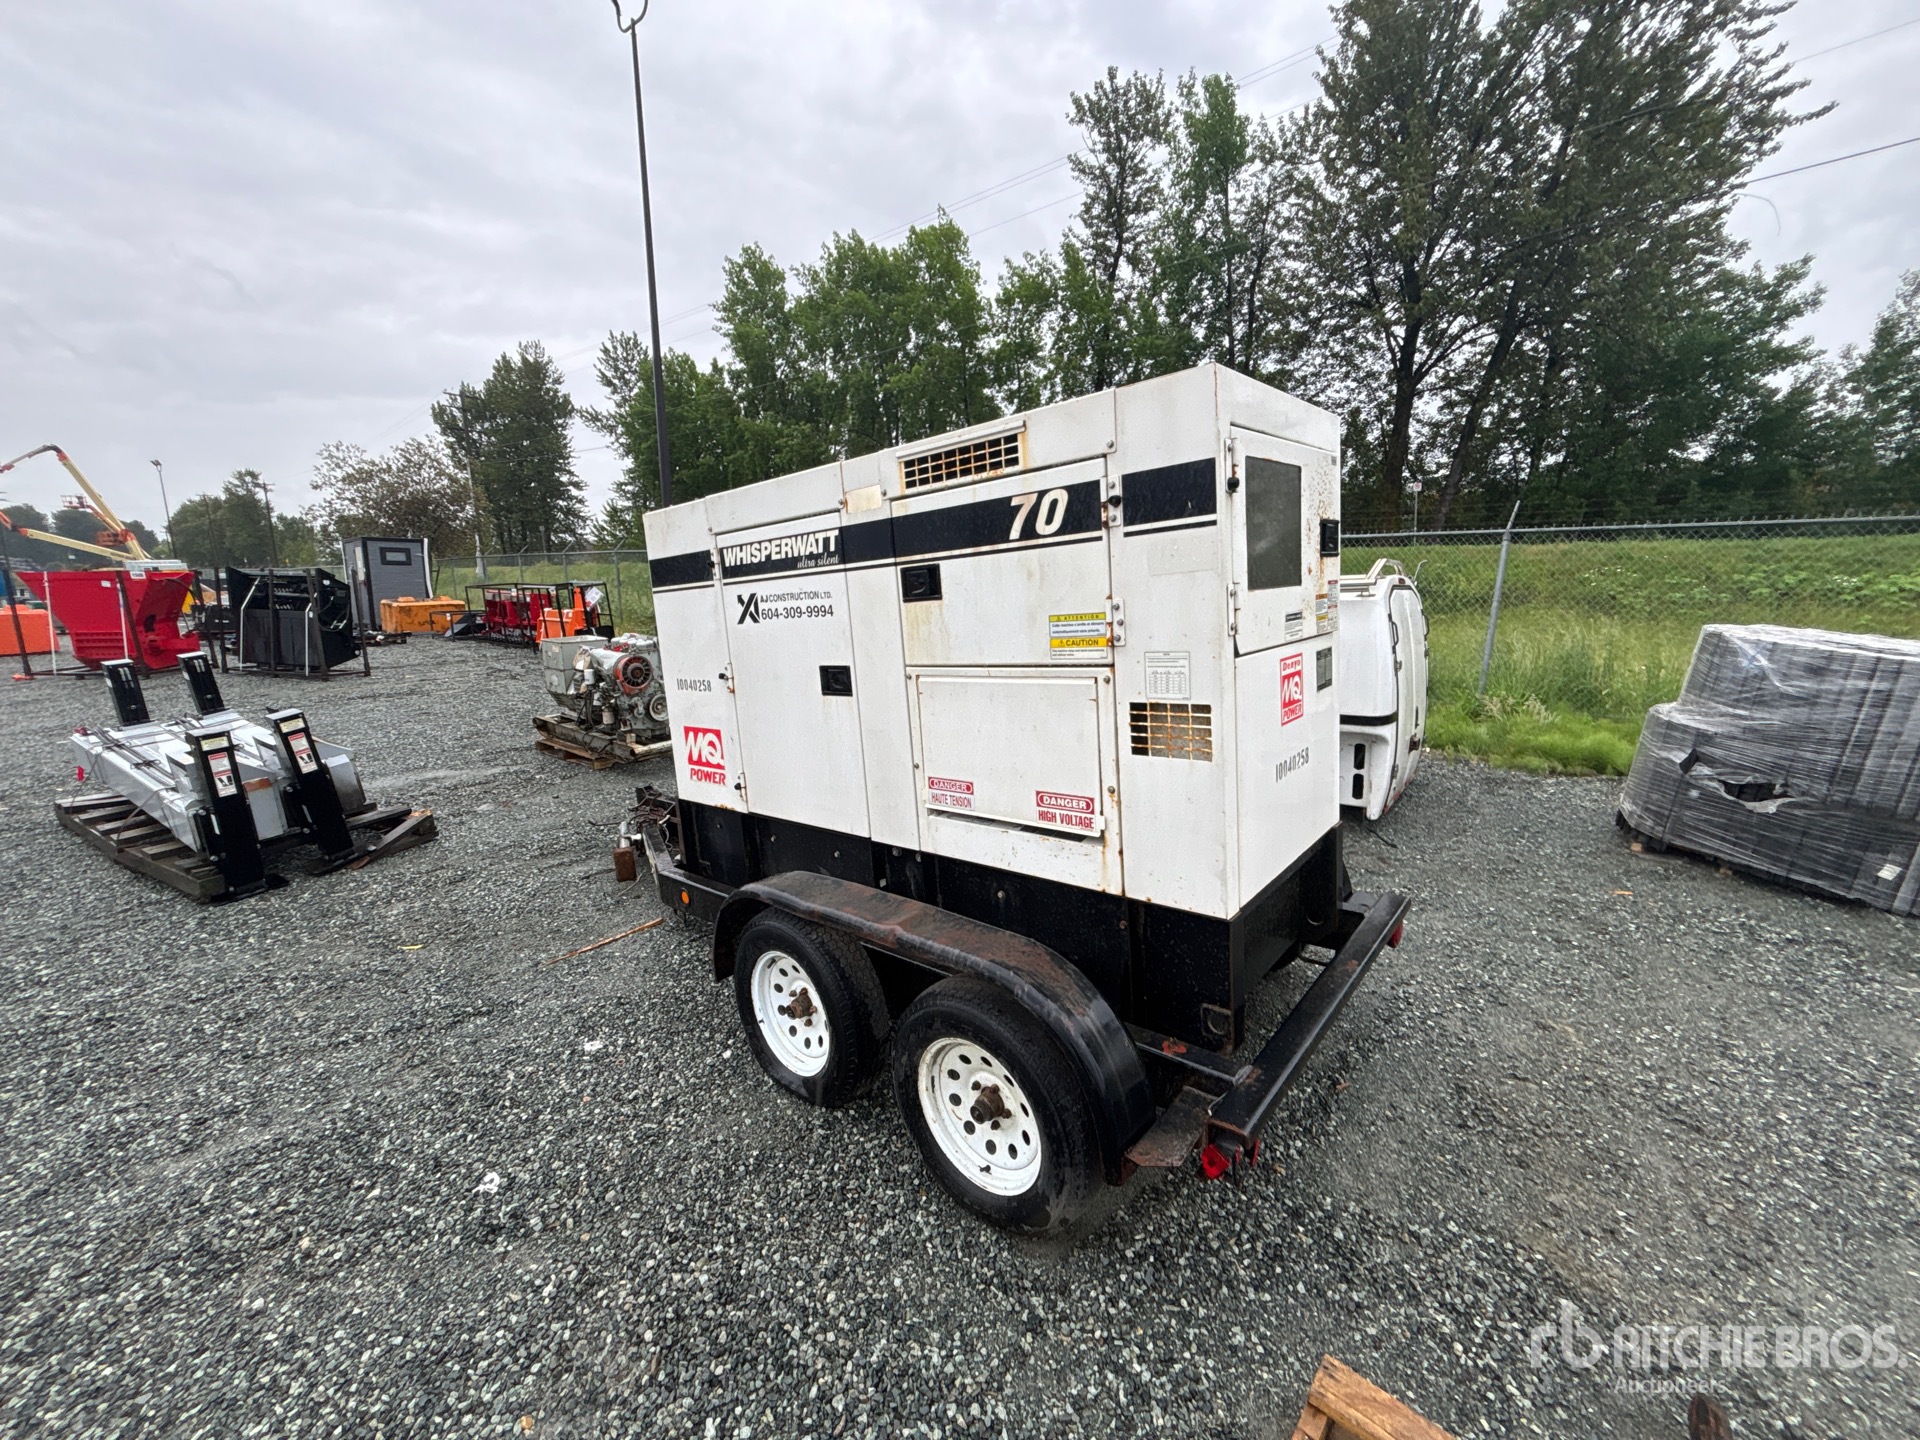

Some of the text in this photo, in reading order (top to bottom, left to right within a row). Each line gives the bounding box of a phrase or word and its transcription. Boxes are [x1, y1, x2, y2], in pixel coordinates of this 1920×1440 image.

[1009, 488, 1069, 540] 70
[723, 529, 839, 567] WHISPERWATT
[797, 552, 839, 569] ultra silent
[761, 604, 834, 620] 604-309-9994
[1065, 639, 1099, 647] CAUTION
[1283, 660, 1301, 672] Denyo
[677, 678, 712, 692] 10040258
[1282, 675, 1302, 703] MQ
[1283, 703, 1302, 720] POWER
[686, 731, 725, 765] MQ
[1276, 747, 1309, 783] 10040258
[690, 768, 726, 786] POWER
[933, 780, 967, 791] DANGER
[931, 792, 972, 808] HAUTE TENSION
[1043, 796, 1087, 810] DANGER
[1038, 810, 1094, 829] HIGH VOLTAGE
